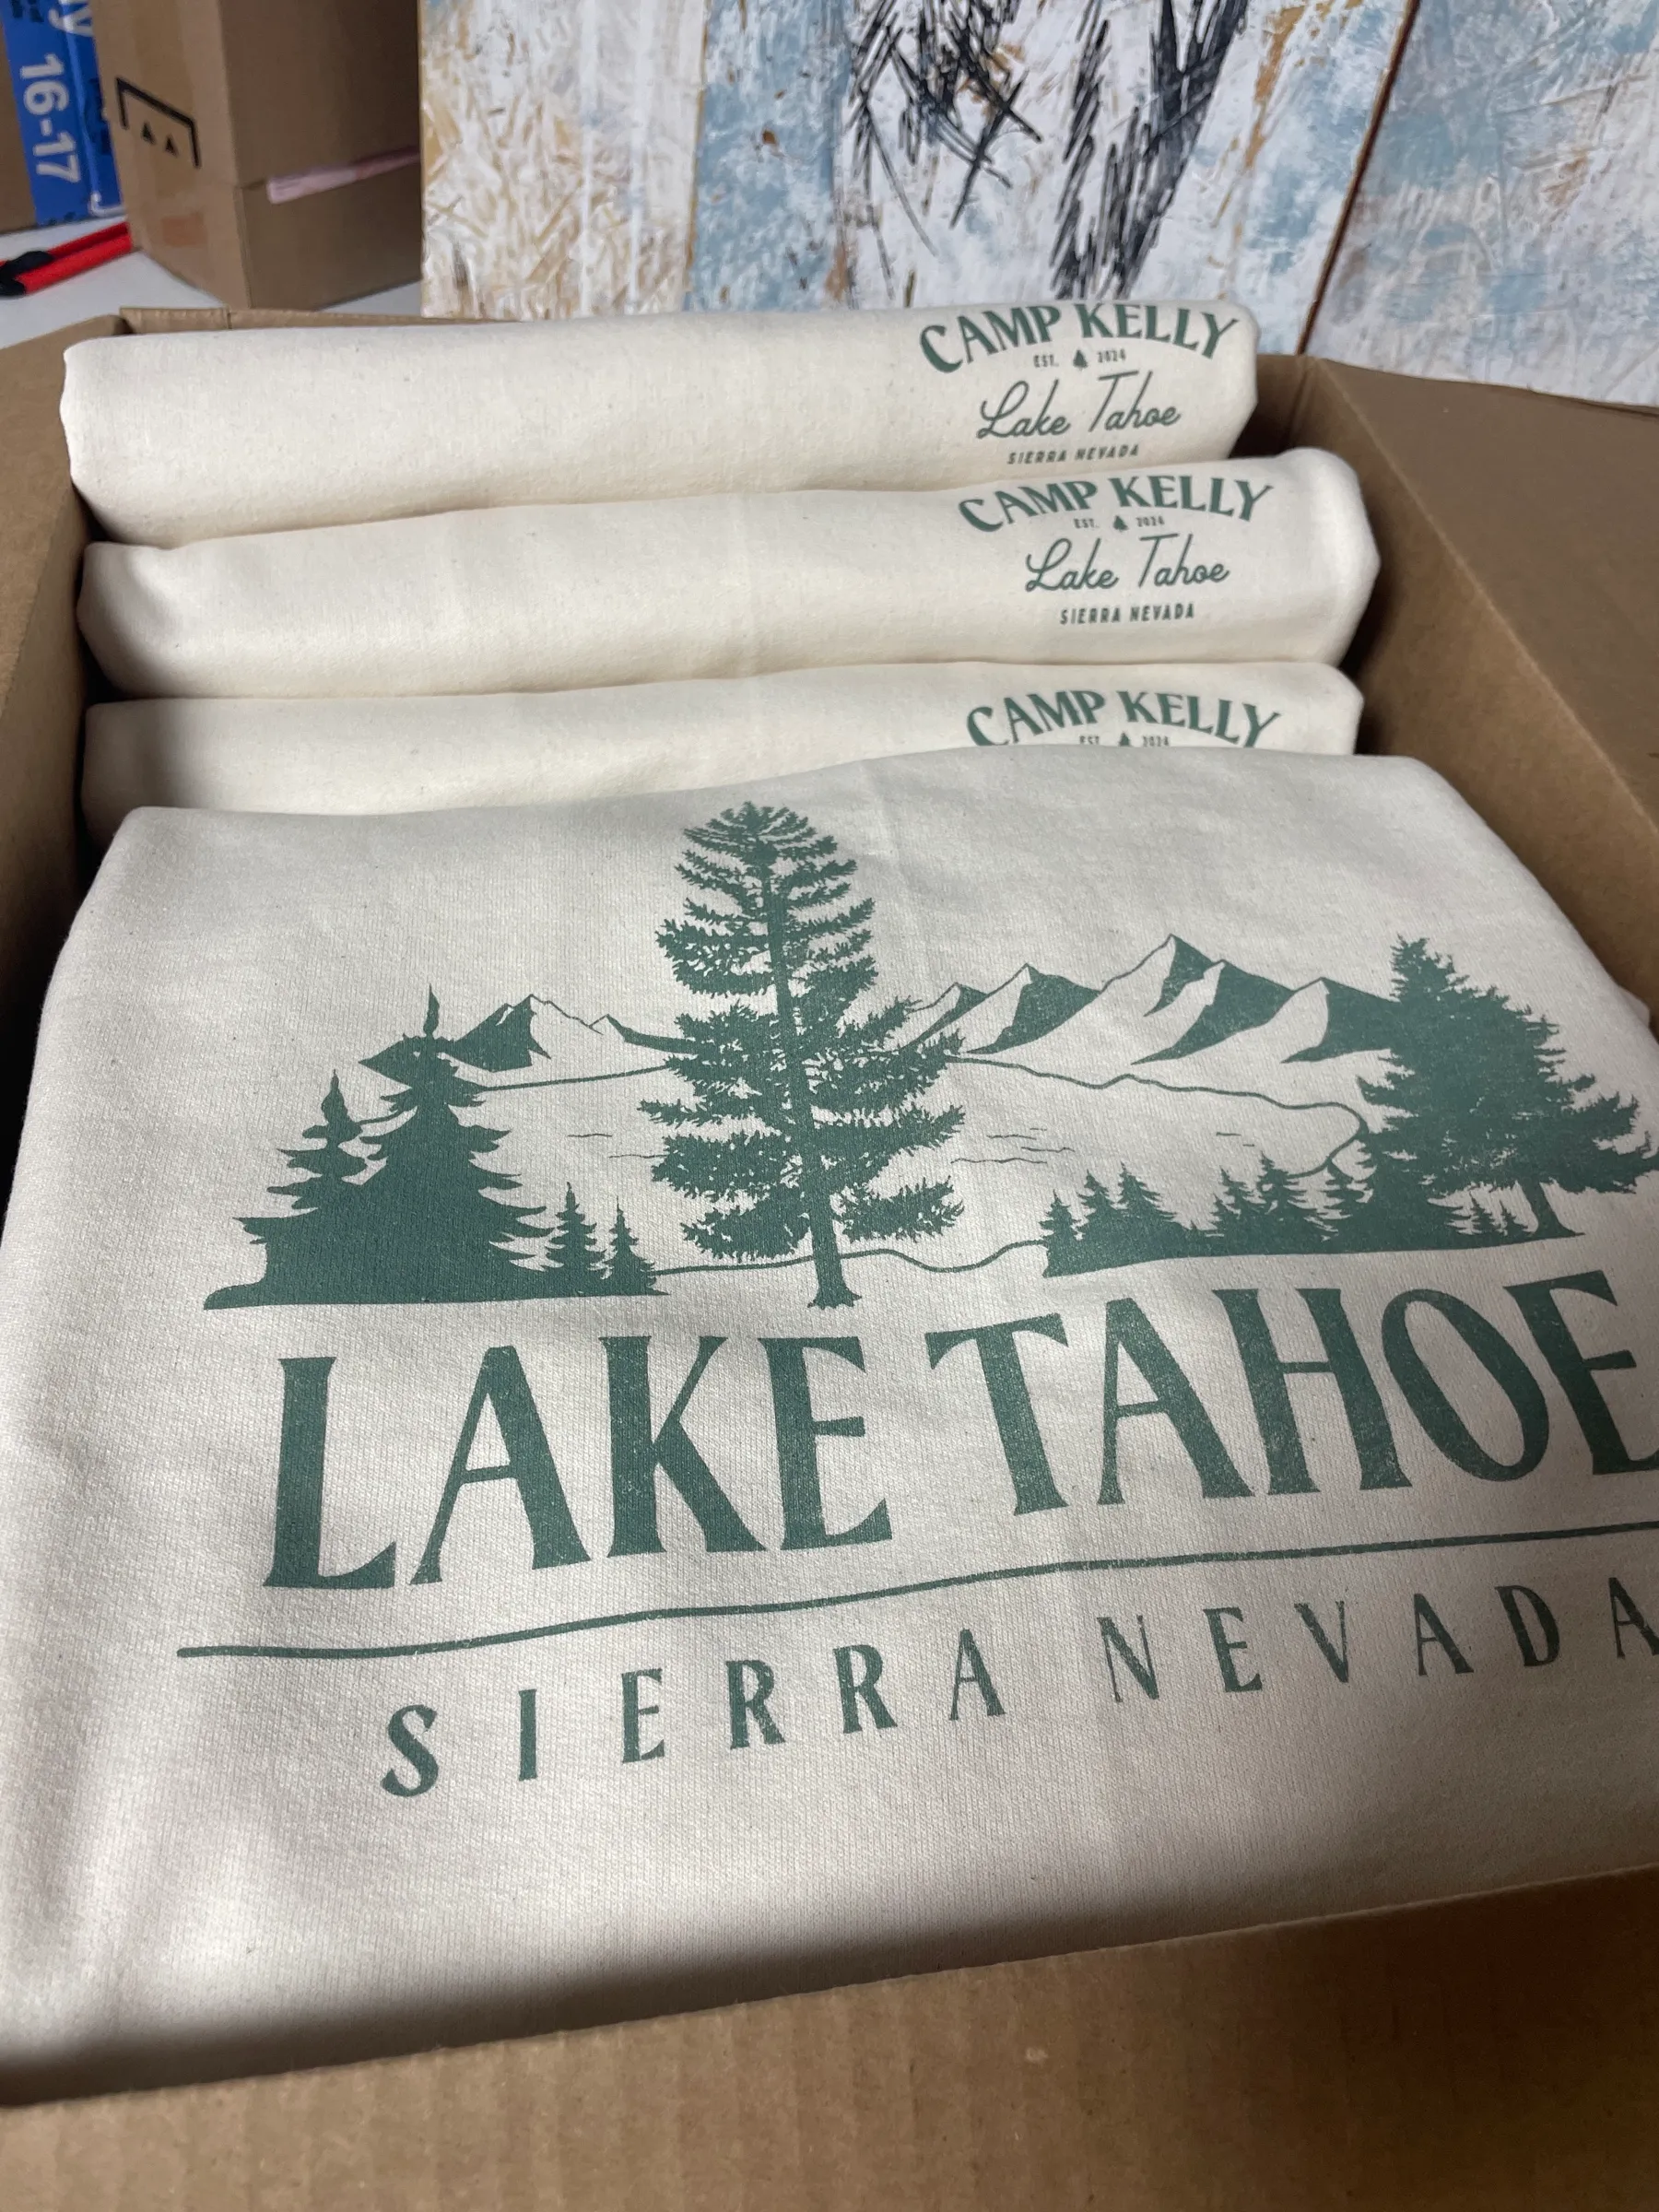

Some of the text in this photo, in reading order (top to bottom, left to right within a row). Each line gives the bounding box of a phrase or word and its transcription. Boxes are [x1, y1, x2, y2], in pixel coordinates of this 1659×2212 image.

[19, 53, 81, 183] 16-17
[919, 302, 1240, 374] CAMP KELLY
[1033, 353, 1059, 368] EST.
[976, 370, 1182, 440] Lake Tahoe
[1007, 443, 1140, 465] SIERRA NEVADA
[959, 475, 1274, 533] CAMP KELLY
[1073, 515, 1165, 529] EST. 2024
[1025, 533, 1230, 592] Lake Tahoe
[1060, 602, 1194, 626] SIERRA NEVADA
[966, 689, 1281, 748] CAMP KELLY
[262, 1270, 1659, 1590] LAKE TAHOE
[381, 1576, 1659, 1798] SIERRA NEVADA
